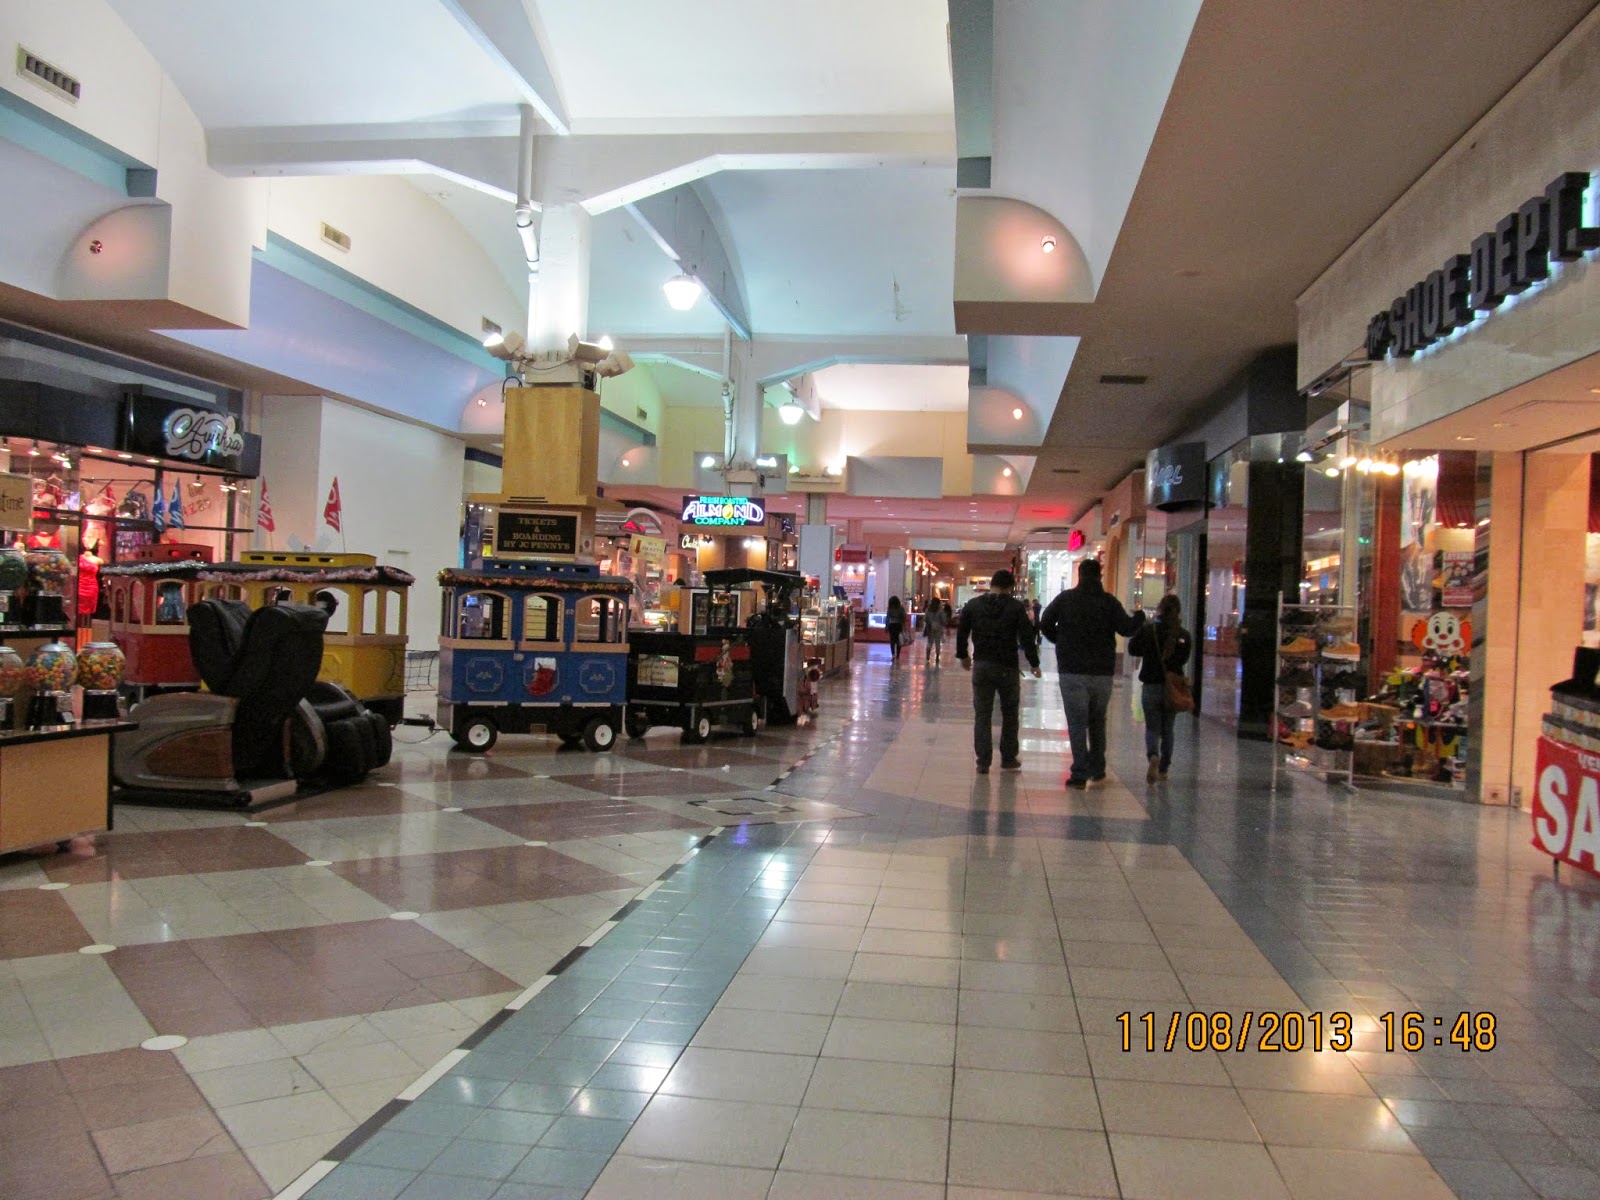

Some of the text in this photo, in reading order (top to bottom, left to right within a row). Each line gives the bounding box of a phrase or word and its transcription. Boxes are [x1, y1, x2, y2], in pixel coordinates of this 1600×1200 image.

[1389, 254, 1471, 358] SHOE
[682, 501, 763, 522] ALMOND
[694, 517, 746, 525] COMPANY
[512, 533, 561, 541] BOARDING
